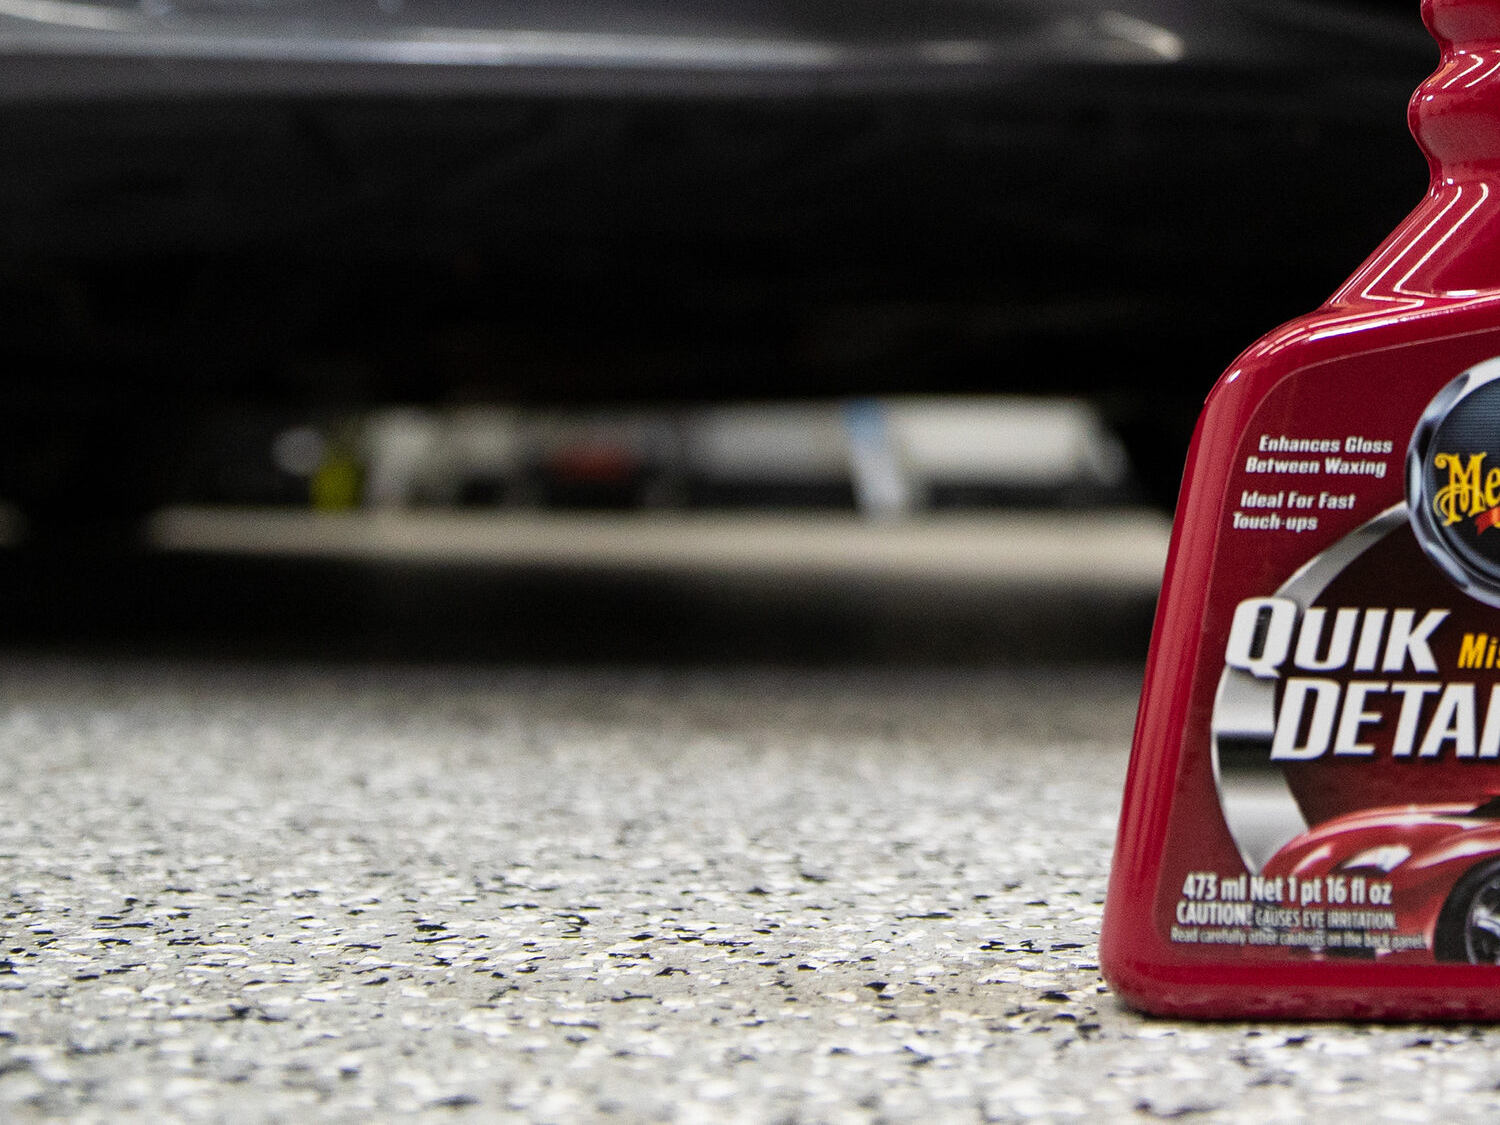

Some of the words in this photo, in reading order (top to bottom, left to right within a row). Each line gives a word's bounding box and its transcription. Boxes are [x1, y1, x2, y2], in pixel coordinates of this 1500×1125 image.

[1259, 434, 1340, 453] Enhances
[1344, 436, 1393, 454] Gloss
[1245, 456, 1320, 474] Between
[1325, 457, 1387, 479] Waxing
[1240, 490, 1285, 508] Ideal
[1287, 491, 1315, 509] For
[1318, 491, 1356, 510] Fast
[1233, 512, 1319, 533] Touch-ups
[1225, 597, 1450, 678] QUIK
[1182, 873, 1217, 901] 473
[1220, 875, 1246, 902] ml
[1250, 875, 1284, 903] Net
[1288, 877, 1297, 903] 1
[1301, 878, 1321, 906] pt
[1326, 877, 1346, 904] 16
[1369, 882, 1392, 906] oz
[1302, 911, 1324, 929] EYE
